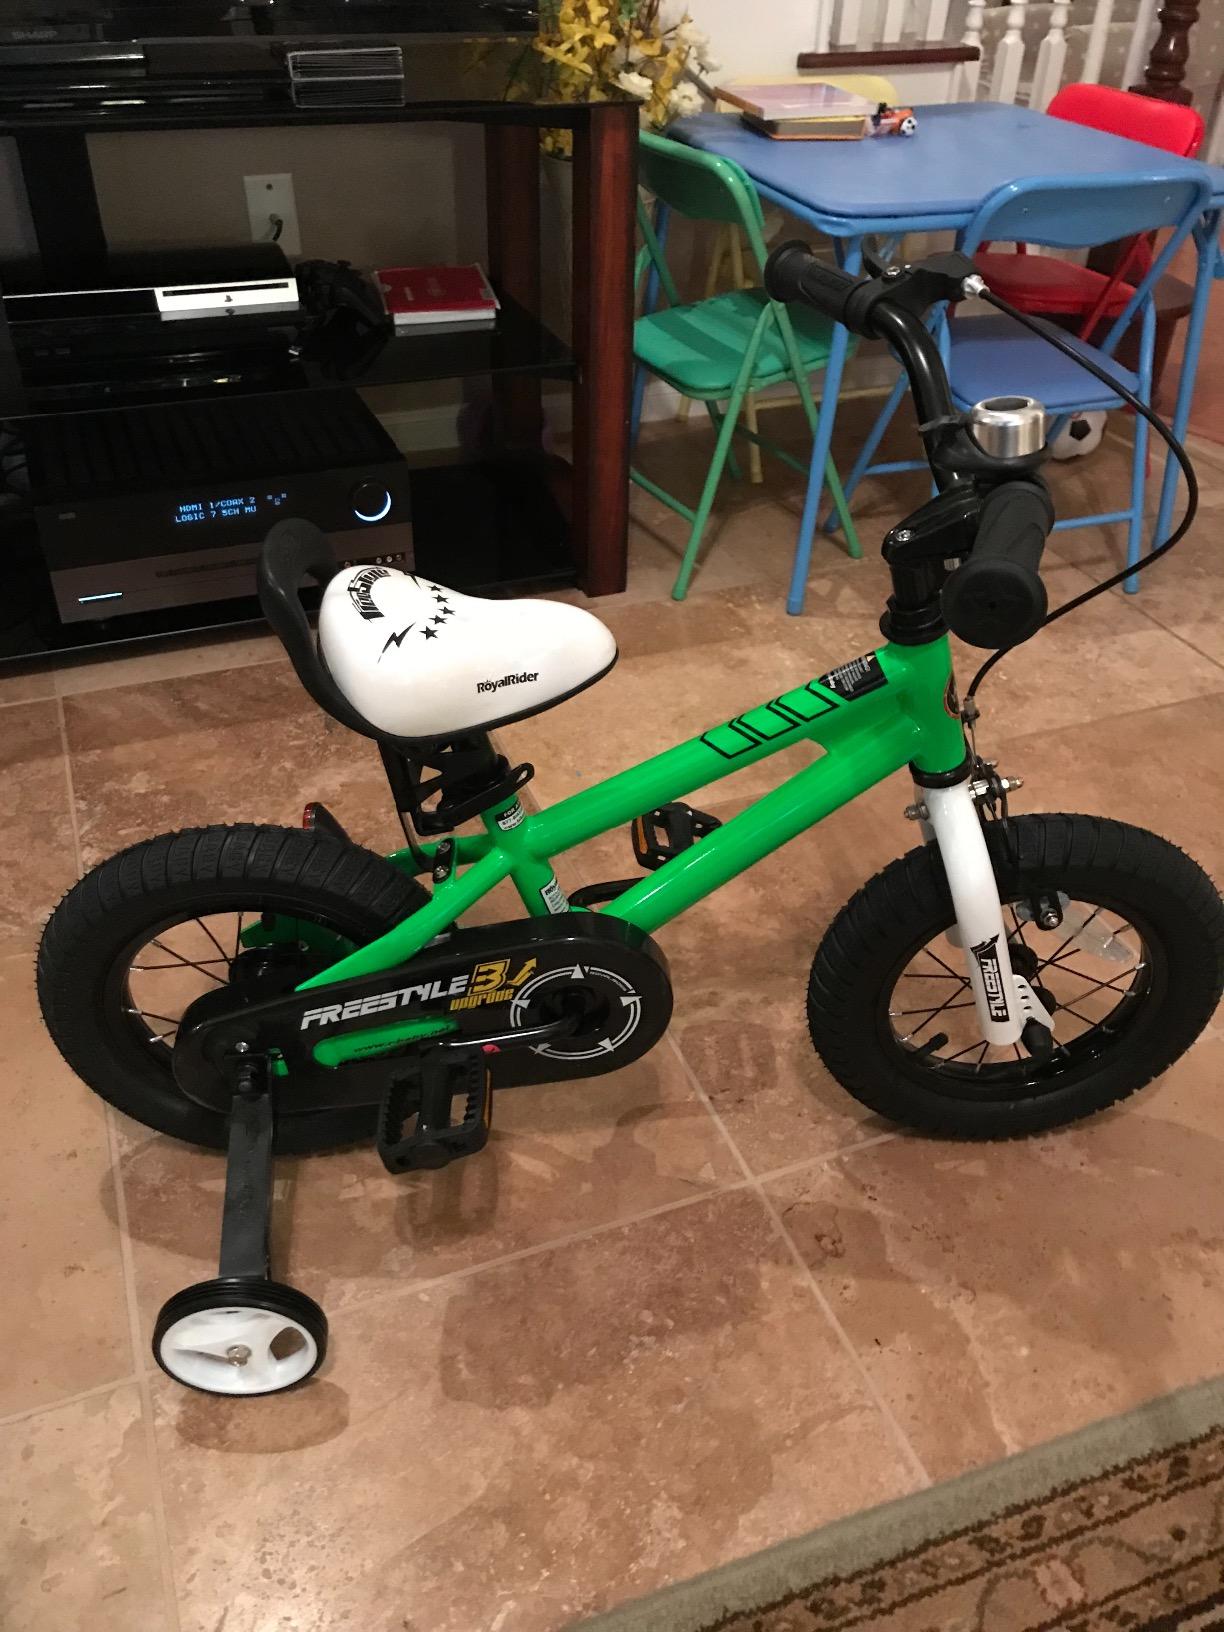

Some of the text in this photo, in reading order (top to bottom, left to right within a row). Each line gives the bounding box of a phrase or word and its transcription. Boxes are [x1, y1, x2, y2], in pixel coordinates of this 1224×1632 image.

[179, 503, 202, 513] HDMI
[249, 496, 255, 504] 2
[175, 512, 205, 523] LOGIC
[477, 672, 539, 693] RoyalRider
[981, 958, 1007, 1017] FREESTYLE
[300, 974, 470, 1030] FREESTYLE
[449, 989, 514, 1011] upgrade
